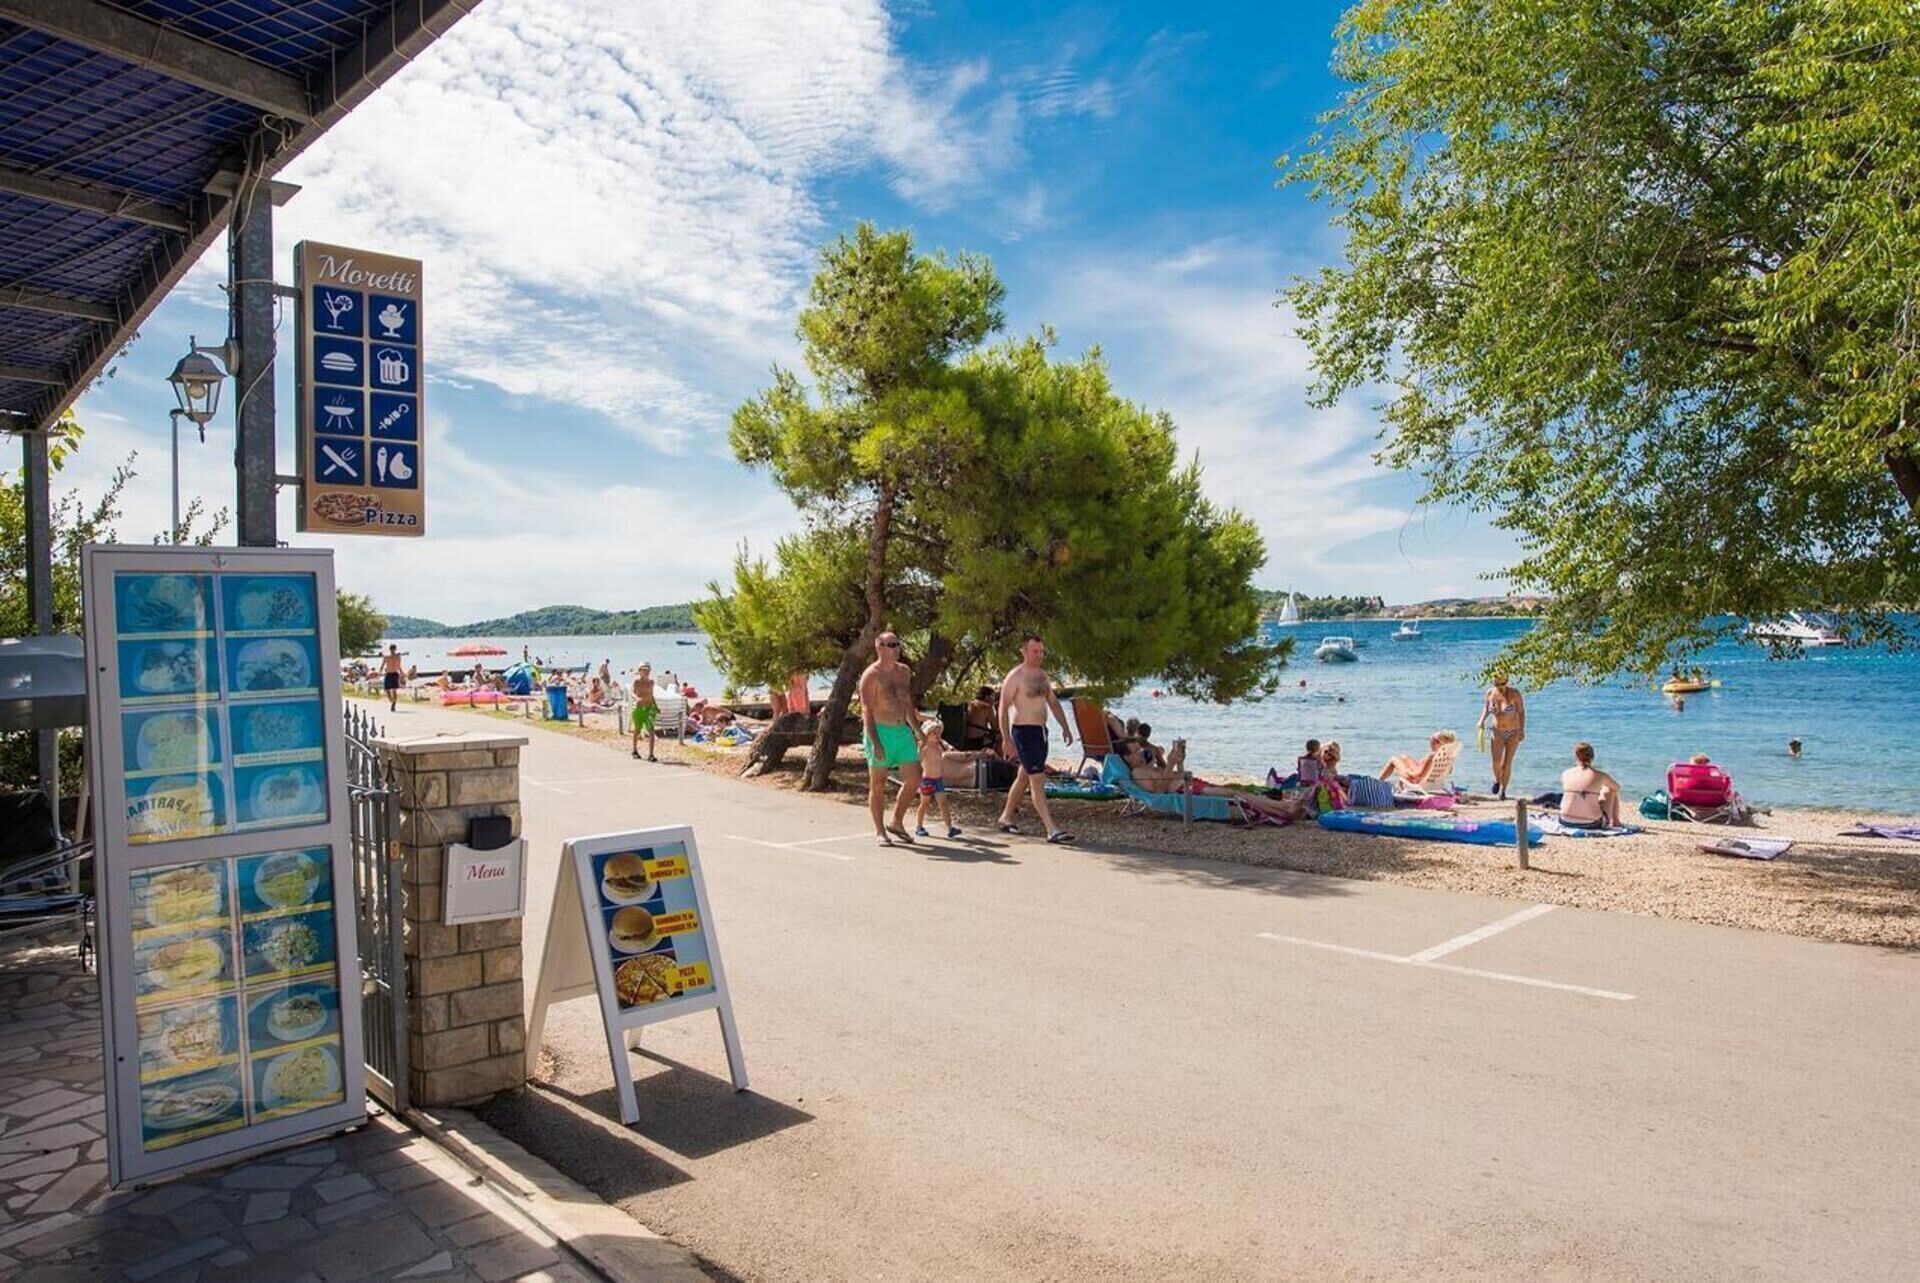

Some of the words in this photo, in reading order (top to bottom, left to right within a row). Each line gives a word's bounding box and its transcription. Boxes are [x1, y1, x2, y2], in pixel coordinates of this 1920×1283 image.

[318, 254, 416, 293] Moretti
[365, 508, 418, 527] Pizza
[466, 863, 505, 881] Menu
